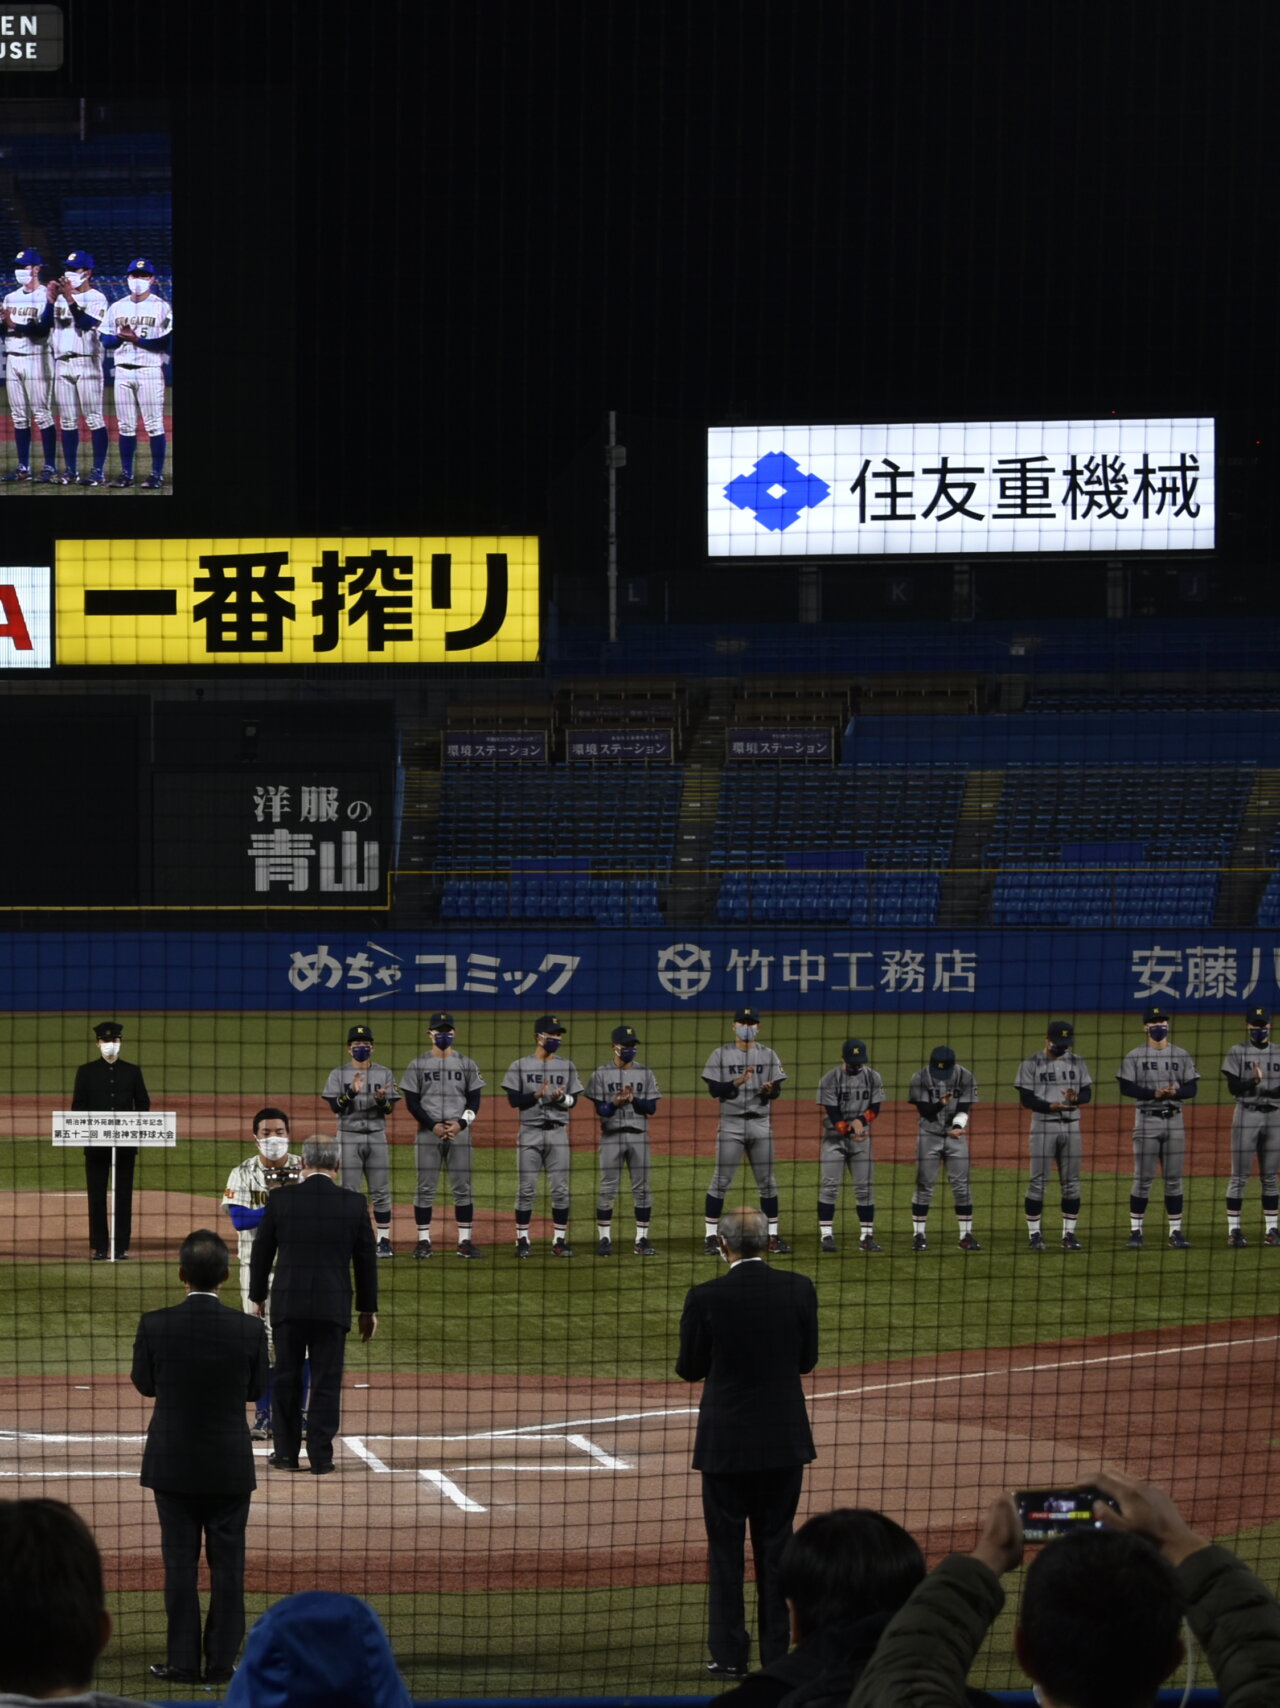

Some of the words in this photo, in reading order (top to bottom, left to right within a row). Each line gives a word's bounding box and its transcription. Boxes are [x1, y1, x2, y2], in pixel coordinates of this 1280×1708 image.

[140, 327, 148, 338] 5
[850, 453, 1201, 523] 住友重機械
[84, 550, 508, 653] 一番搾り
[447, 744, 540, 757] 環境ステーション
[572, 743, 666, 756] 環境ステーション
[732, 742, 827, 754] 環境ステーション
[253, 785, 372, 822] 洋服の
[247, 829, 380, 892] 青山
[726, 948, 978, 993] 竹中工務店
[1142, 1061, 1179, 1072] KEIO
[424, 1071, 462, 1081] KEIO
[526, 1074, 563, 1085] KEIO
[1039, 1071, 1076, 1082] KEIO
[103, 1130, 174, 1139] 明治神宮野球大会
